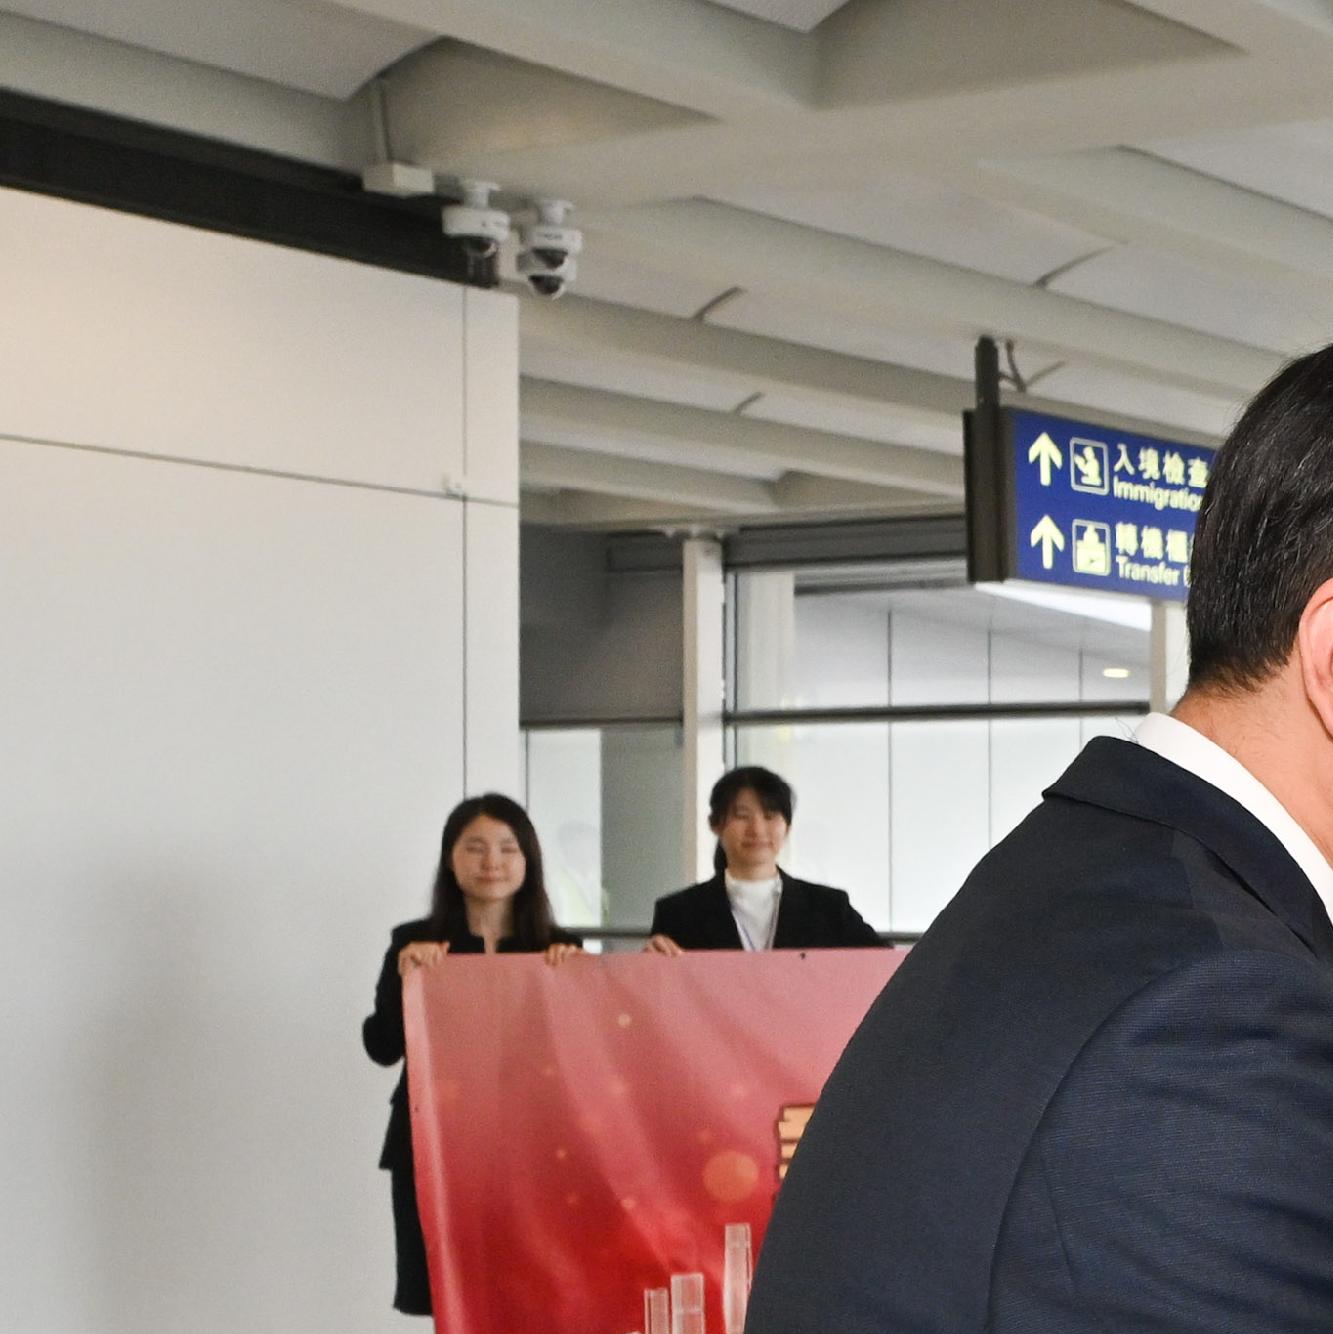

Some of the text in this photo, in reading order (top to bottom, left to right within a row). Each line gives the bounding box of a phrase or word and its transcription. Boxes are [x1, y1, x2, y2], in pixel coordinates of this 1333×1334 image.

[1115, 521, 1194, 564] 轉機櫃
[1116, 555, 1180, 586] Transfer
